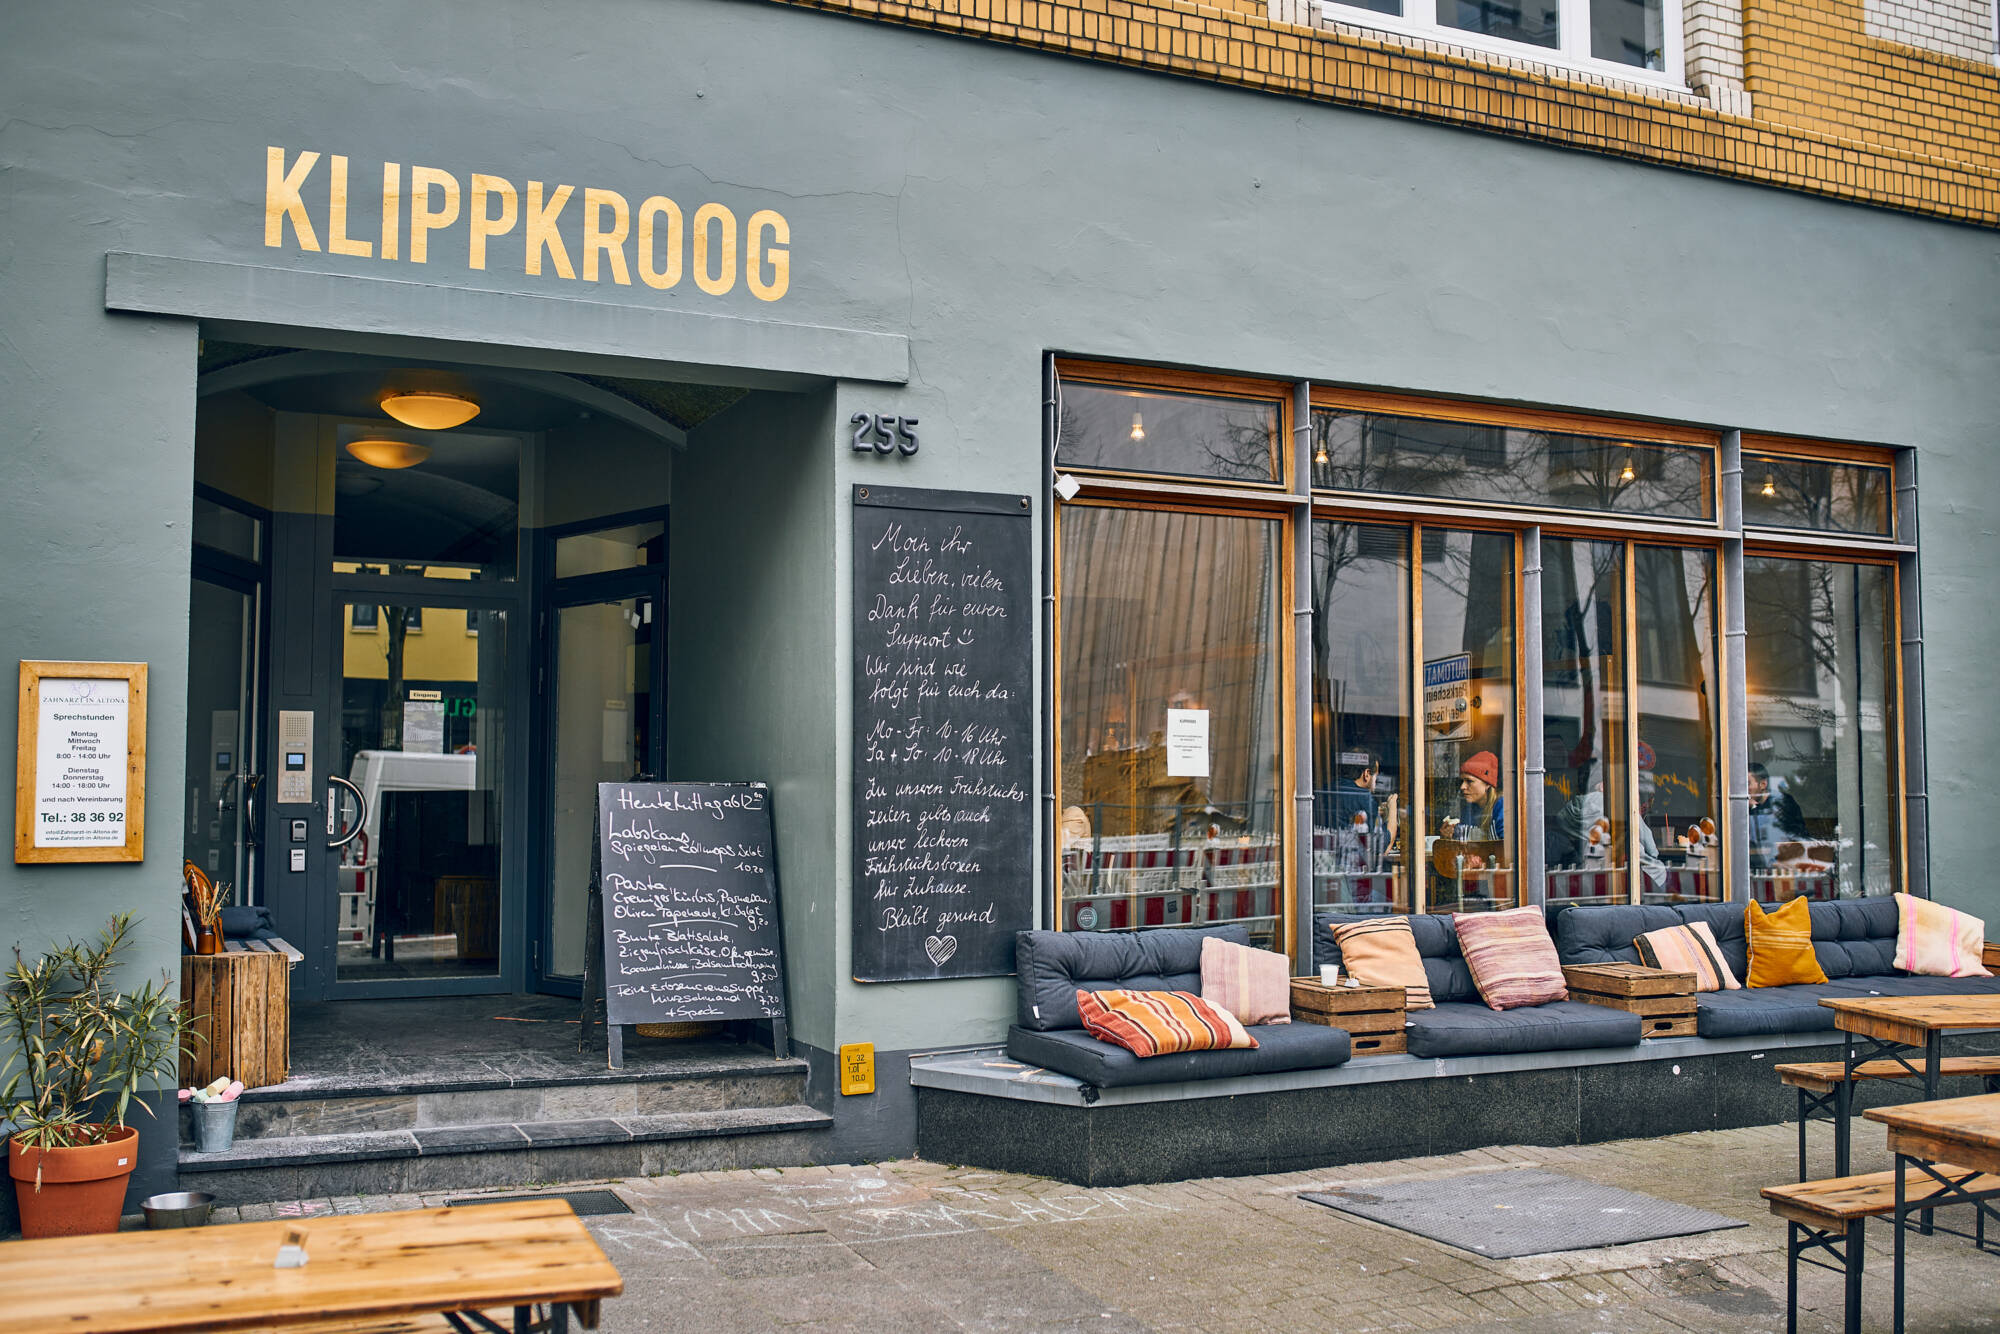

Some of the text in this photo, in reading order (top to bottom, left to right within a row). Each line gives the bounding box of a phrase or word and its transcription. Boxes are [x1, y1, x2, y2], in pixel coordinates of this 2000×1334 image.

[264, 146, 791, 302] KLIPPKROOG
[851, 411, 920, 457] 255
[940, 525, 973, 553] ihr
[961, 564, 1004, 592] vielen
[868, 593, 1008, 622] Dank für euren
[886, 622, 951, 650] Support
[865, 655, 968, 677] Wir sind wie
[868, 678, 909, 708] folgt
[917, 678, 941, 703] für
[948, 679, 981, 698] euch
[53, 713, 115, 721] Sprechstunden
[979, 723, 1008, 746] Uhr
[866, 741, 885, 762] Sa
[980, 749, 1008, 765] Uhr
[866, 777, 887, 800] Zu
[895, 783, 943, 796] unseren
[41, 812, 124, 822] Tel.: 38 36 92
[954, 805, 990, 823] auch
[868, 837, 906, 852] unsere
[865, 852, 981, 877] Frühstücksboxen
[874, 879, 899, 900] für
[878, 902, 996, 932] Bleibt gesund
